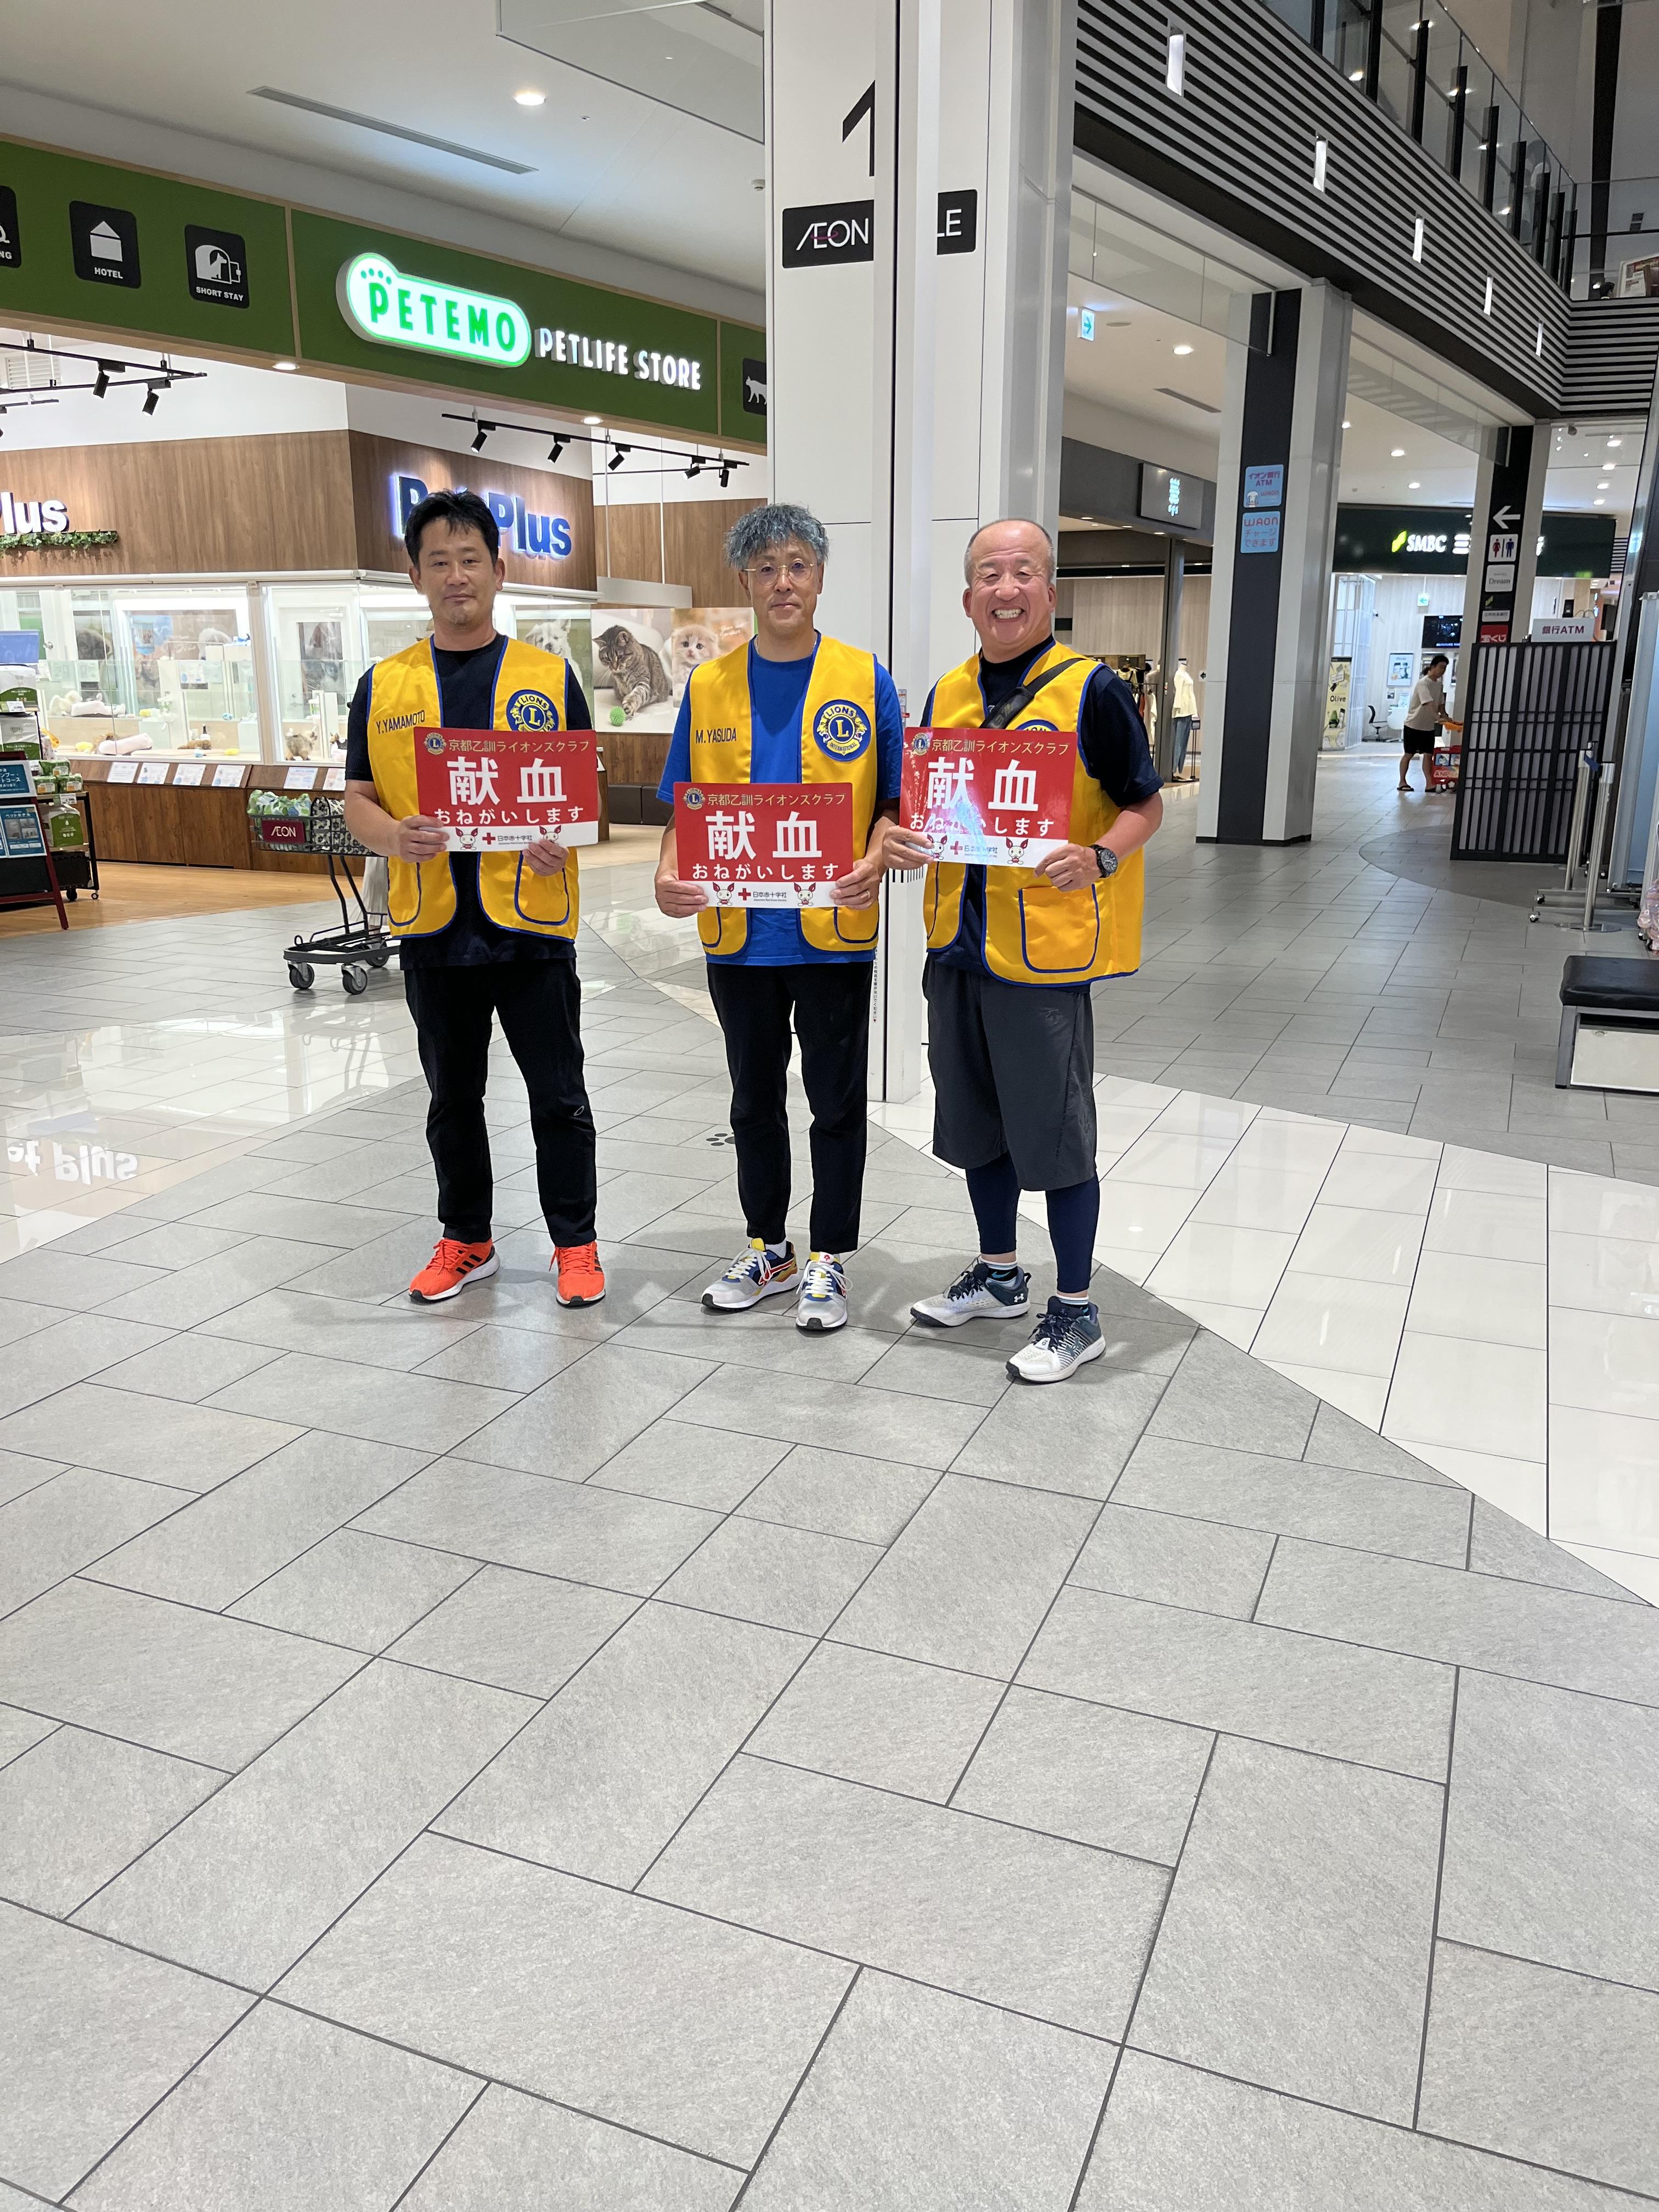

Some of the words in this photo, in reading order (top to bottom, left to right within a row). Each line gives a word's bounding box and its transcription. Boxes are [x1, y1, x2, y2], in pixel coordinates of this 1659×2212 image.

[94, 267, 123, 279] HOTEL
[196, 286, 222, 297] SHORT
[224, 292, 244, 301] STAY
[369, 282, 517, 352] PETEMO
[534, 327, 629, 375] PETLIFE
[634, 350, 701, 391] STORE
[0, 492, 70, 534] lus
[488, 491, 572, 557] Plus
[1244, 527, 1277, 538] チャージ
[1244, 537, 1277, 547] できます
[1406, 534, 1447, 553] SMBC
[1542, 625, 1585, 635] 銀行ATM
[520, 695, 548, 708] LIONS
[528, 707, 541, 727] L
[826, 706, 855, 717] LIONS
[376, 709, 426, 735] Y.YAMAMOTO
[835, 719, 850, 738] L
[695, 726, 737, 744] M.YASUDA
[448, 738, 590, 753] 京都乙訓ライオンズクラブ
[932, 738, 1069, 755] 京都乙訓ライオンズクラブ
[446, 755, 567, 806] 献血
[926, 756, 1039, 812] 献血
[707, 793, 845, 806] 京都乙訓ライオンズクラブ
[434, 806, 584, 825] おねがいします
[705, 810, 822, 861] 献血
[692, 863, 838, 879] おねがいします
